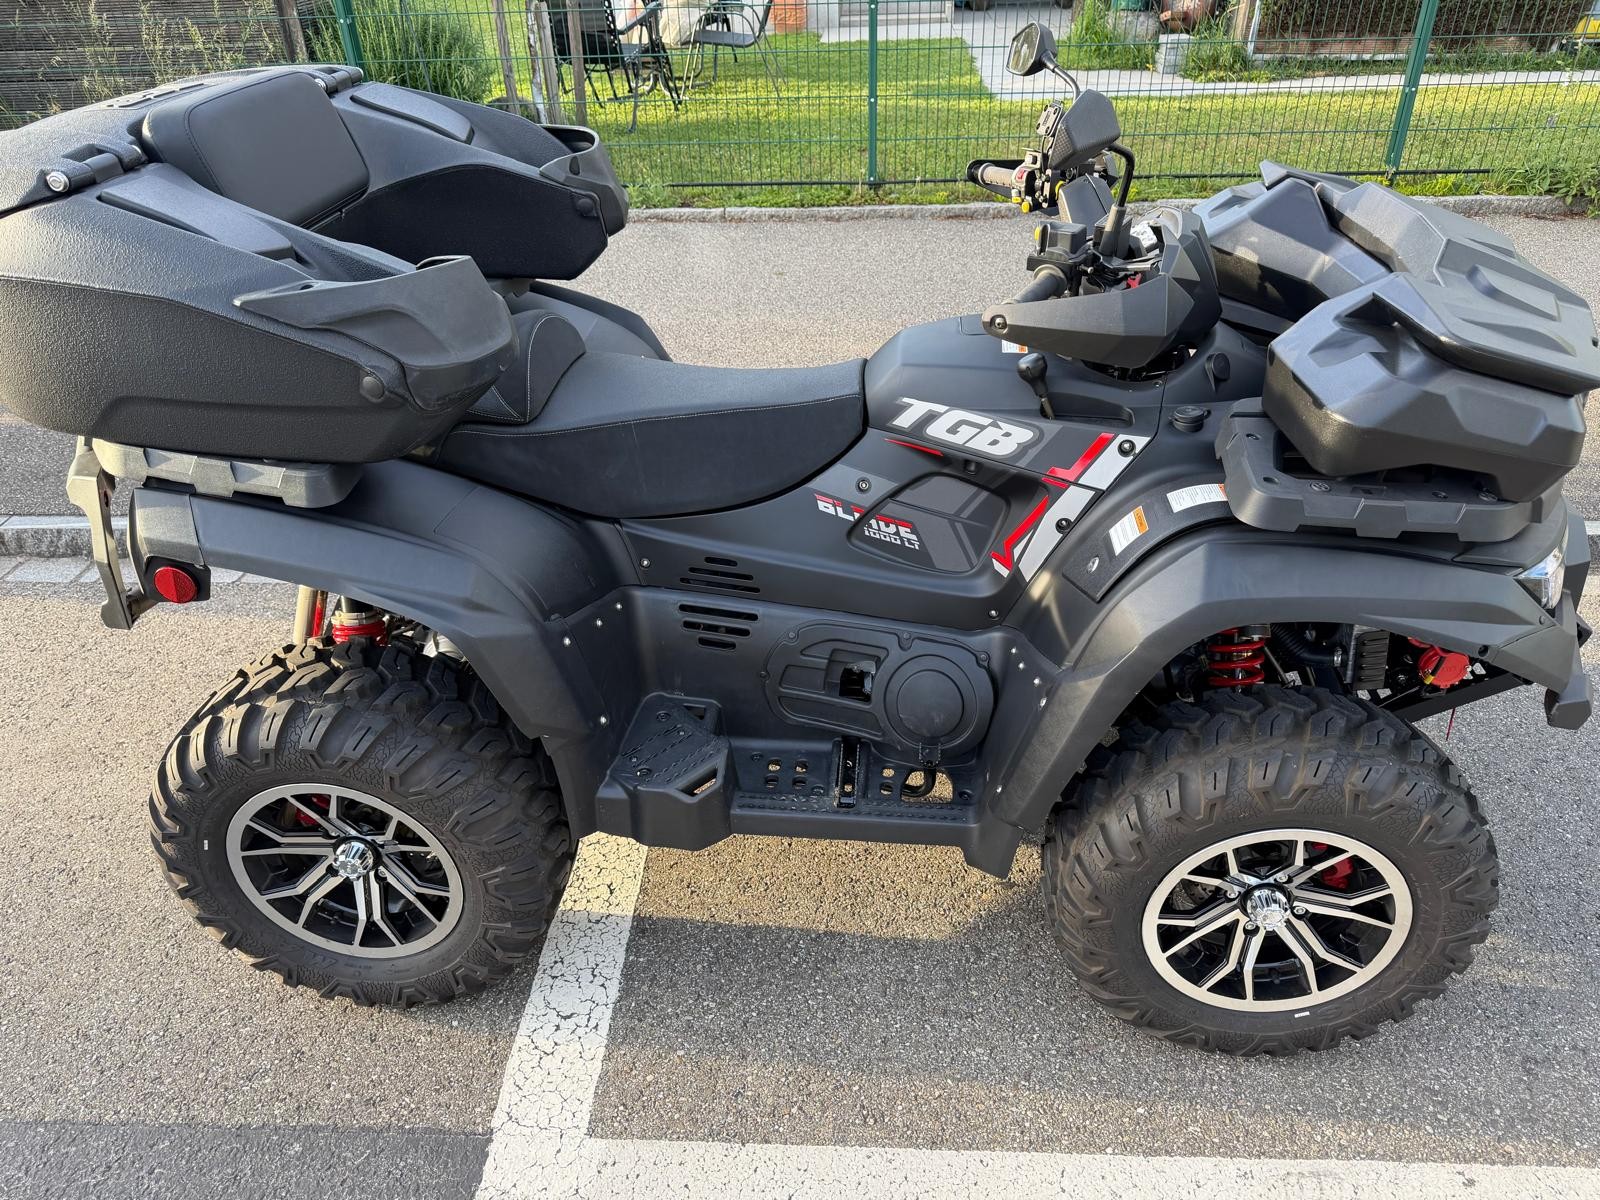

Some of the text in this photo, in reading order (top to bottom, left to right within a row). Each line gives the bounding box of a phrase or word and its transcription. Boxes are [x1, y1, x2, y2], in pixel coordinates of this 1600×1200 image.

[892, 397, 1034, 455] TGB
[814, 493, 918, 541] BLADE
[864, 525, 920, 550] 1000 LT
